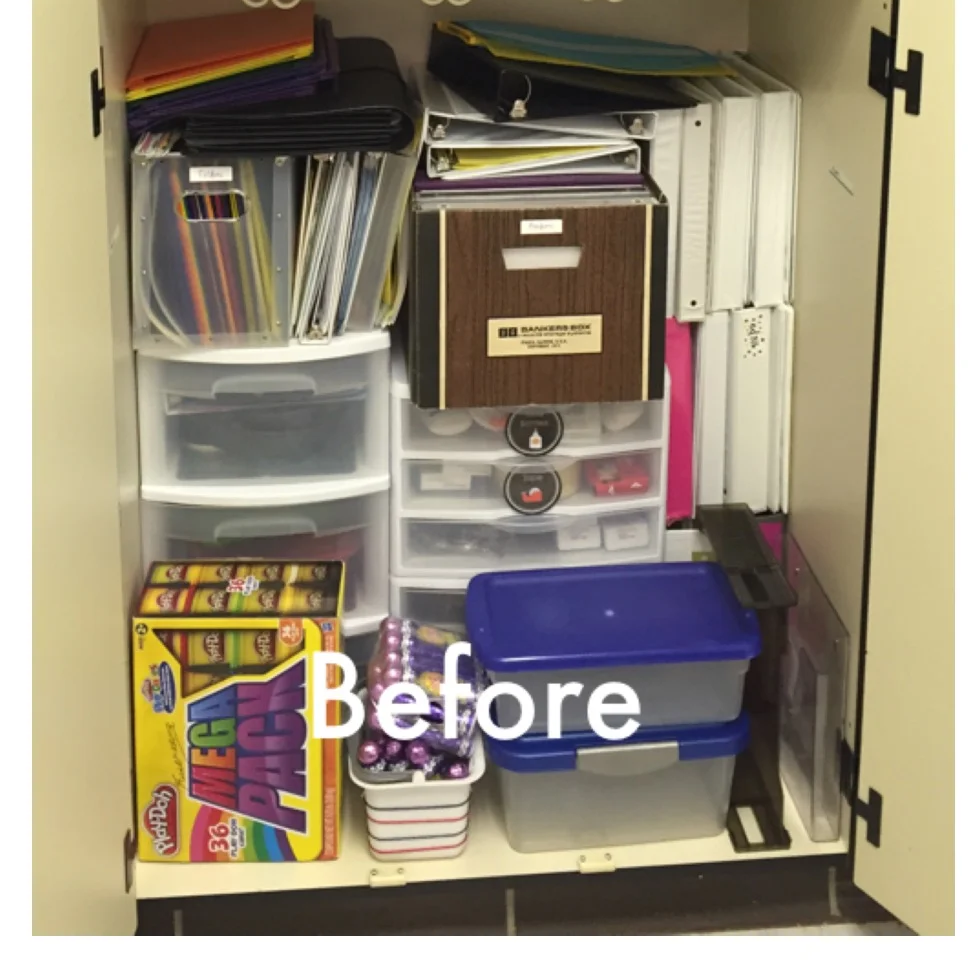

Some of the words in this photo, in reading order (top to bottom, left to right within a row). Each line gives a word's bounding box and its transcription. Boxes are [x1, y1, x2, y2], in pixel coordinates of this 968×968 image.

[190, 683, 236, 809] MEGA
[238, 658, 307, 834] PACK
[148, 789, 174, 857] Play-Doh
[209, 823, 231, 853] 36
